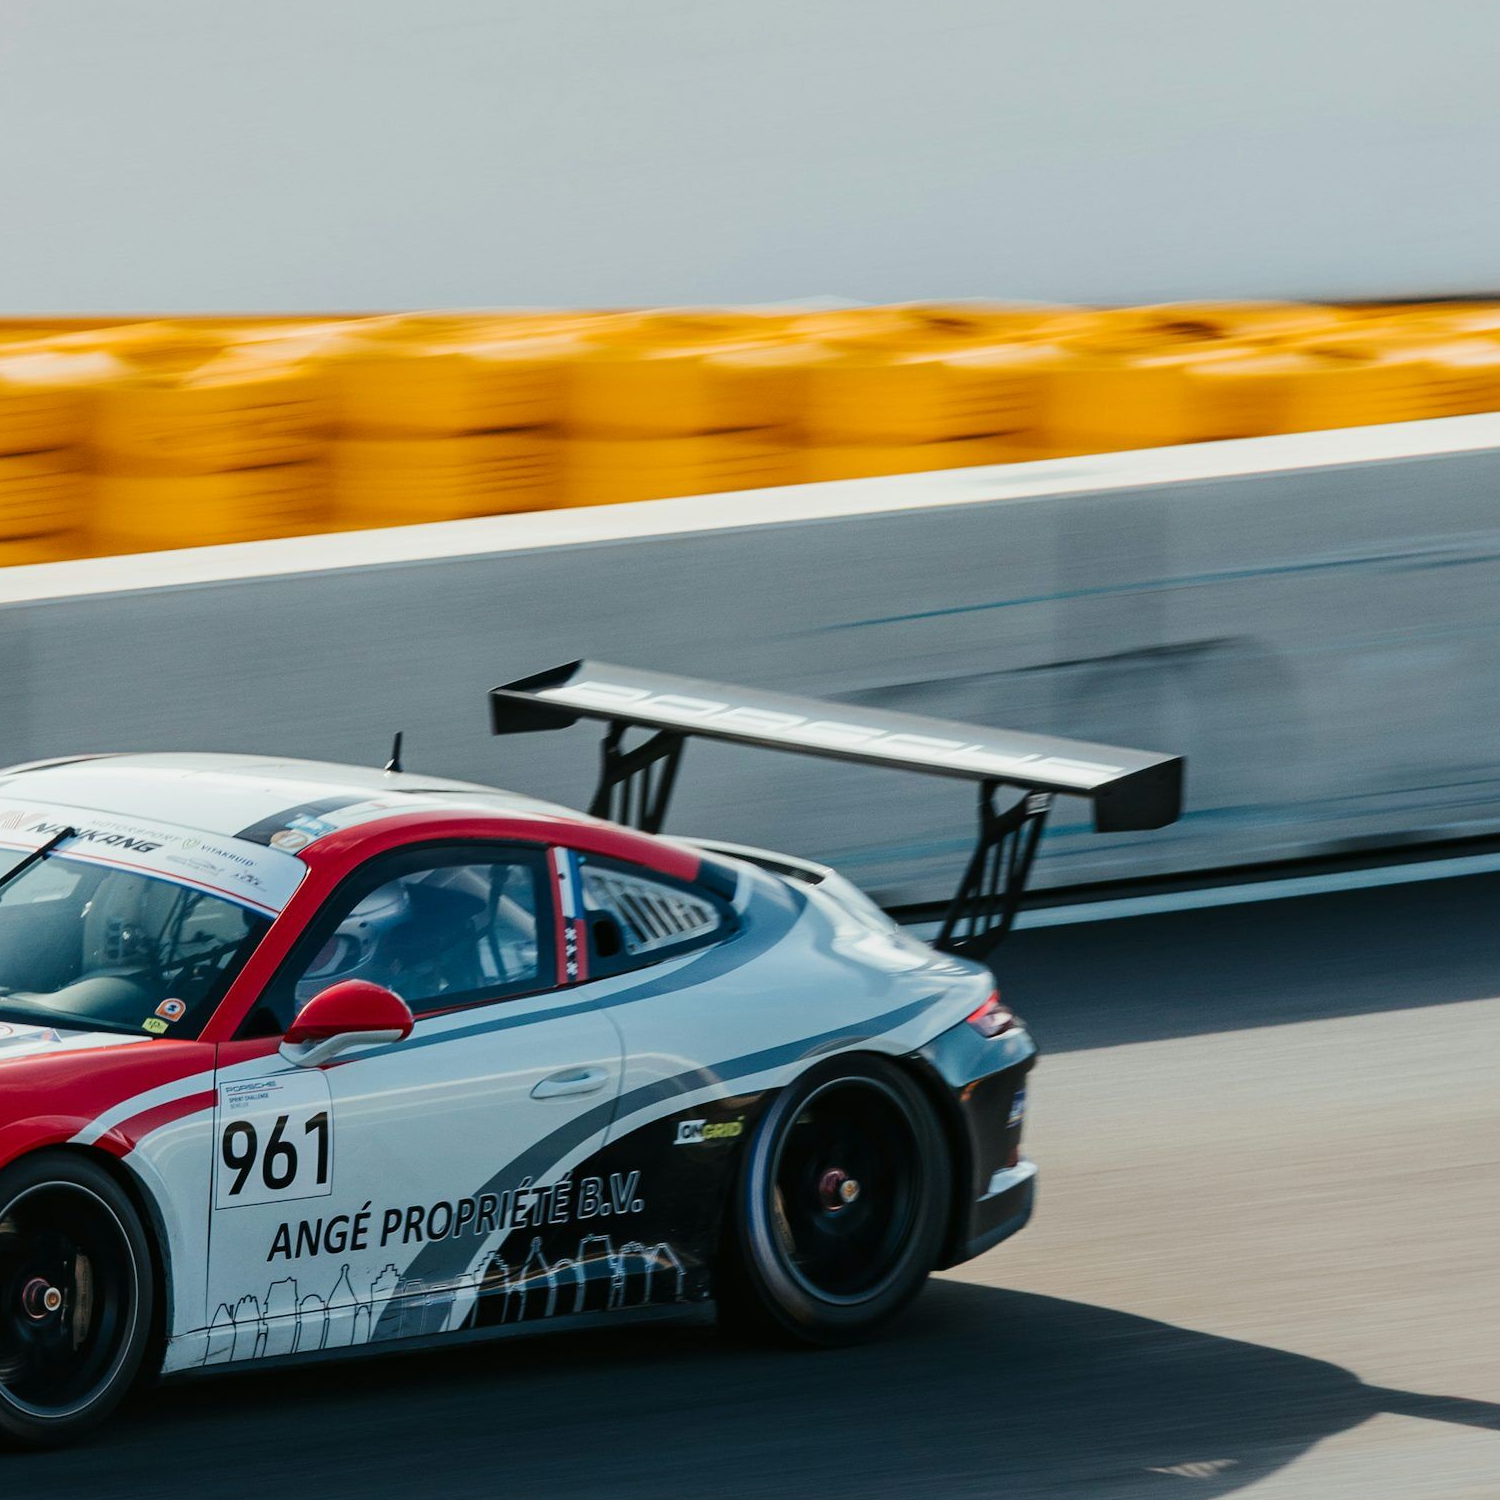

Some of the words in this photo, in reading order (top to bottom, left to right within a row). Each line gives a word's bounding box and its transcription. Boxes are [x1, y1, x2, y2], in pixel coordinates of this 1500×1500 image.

[226, 1081, 277, 1093] PORSCHE
[222, 1111, 329, 1196] 961
[266, 1200, 372, 1262] ANGÉ
[379, 1171, 574, 1248] PROPRIÉTÉ
[576, 1169, 645, 1220] B.V.
